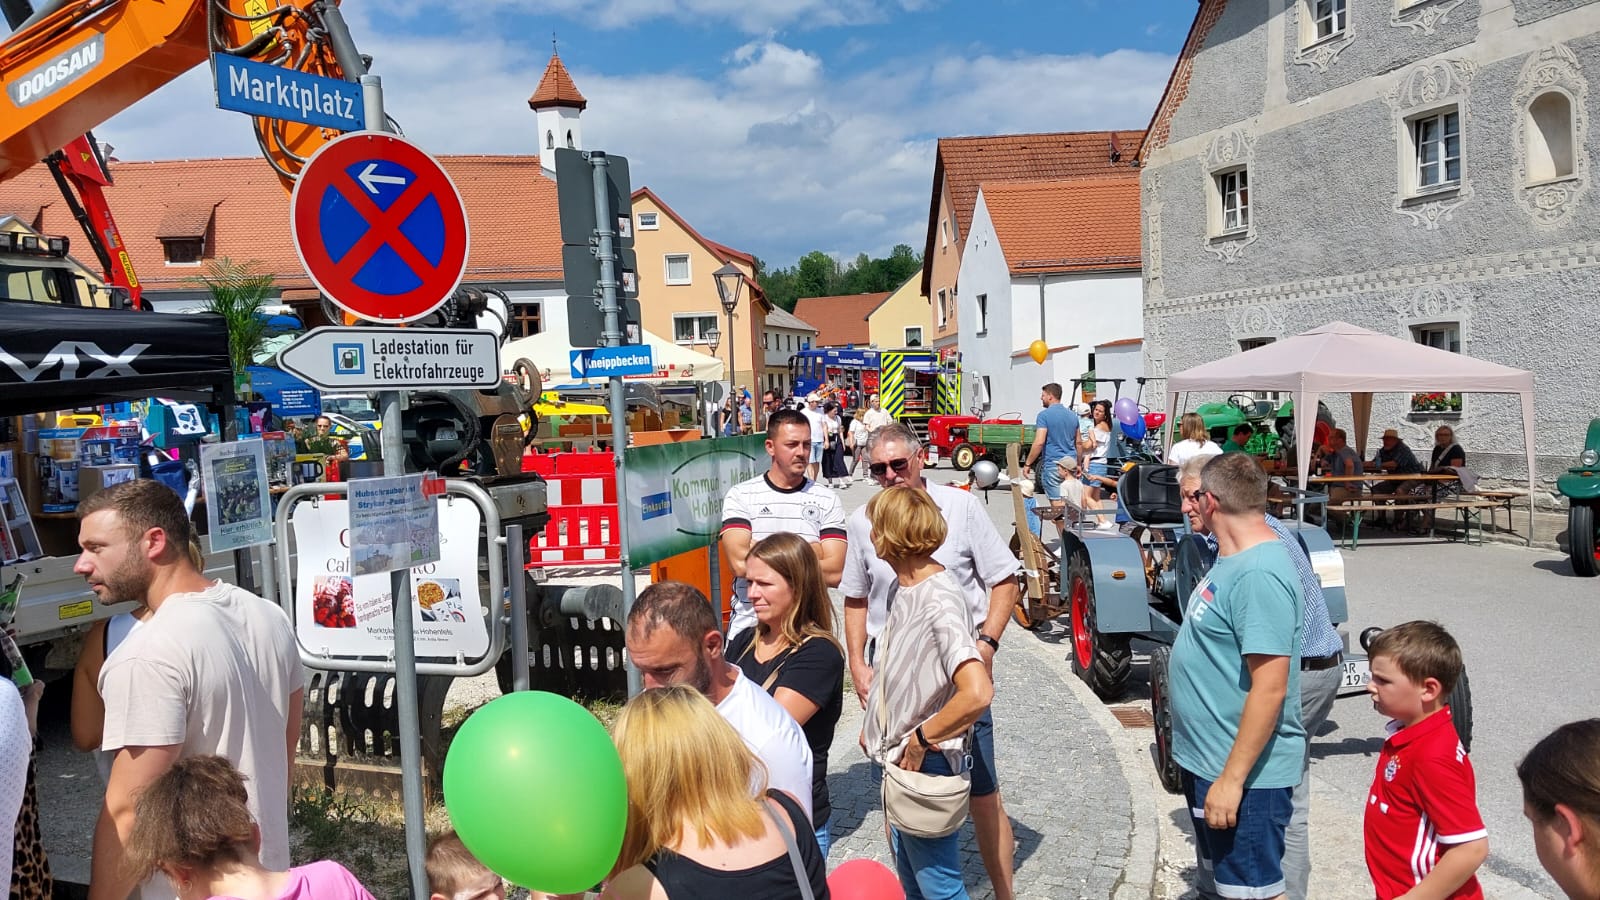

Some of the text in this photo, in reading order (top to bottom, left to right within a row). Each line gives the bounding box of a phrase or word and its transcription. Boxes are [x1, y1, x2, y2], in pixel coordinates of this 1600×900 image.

[19, 42, 97, 103] DOOSAN
[229, 65, 354, 119] Marktplatz
[372, 338, 474, 355] Ladestation für
[585, 355, 650, 370] Kneippbecken
[374, 362, 484, 382] Elektrofahrzeuge
[355, 488, 405, 498] Hubschrauber
[672, 476, 720, 499] Kommun
[642, 500, 671, 514] Einkaufen
[692, 497, 724, 519] Hohen
[367, 626, 395, 635] Marktpla
[1343, 662, 1357, 673] AR
[1346, 674, 1361, 686] 19
